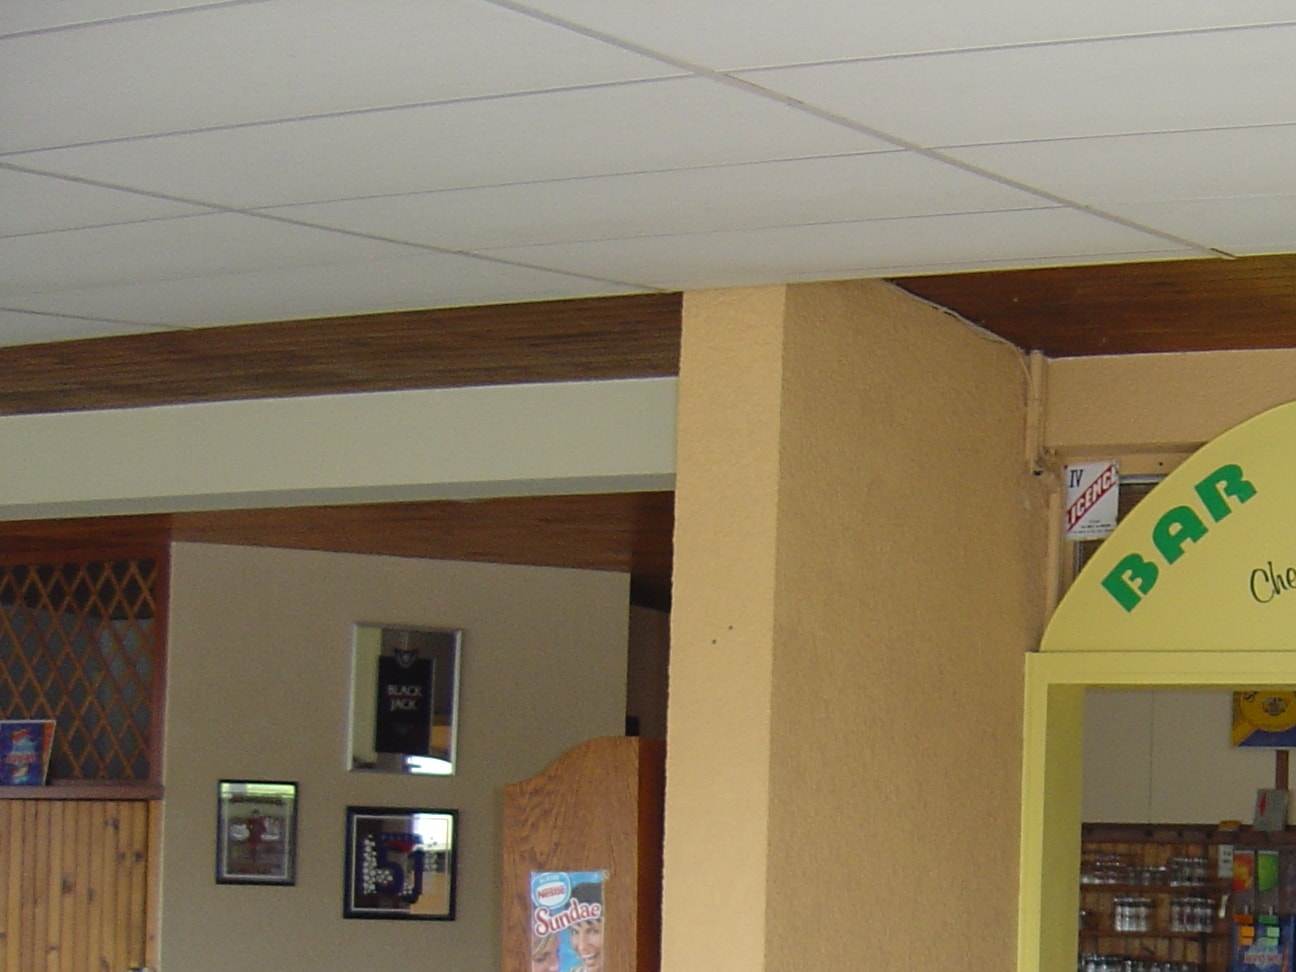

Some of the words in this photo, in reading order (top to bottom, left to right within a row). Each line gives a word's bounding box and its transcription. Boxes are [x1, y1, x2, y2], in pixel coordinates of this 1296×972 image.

[1070, 469, 1083, 488] IV
[1101, 463, 1258, 613] BAR
[387, 684, 422, 696] BLACK
[535, 899, 601, 936] Sundae
